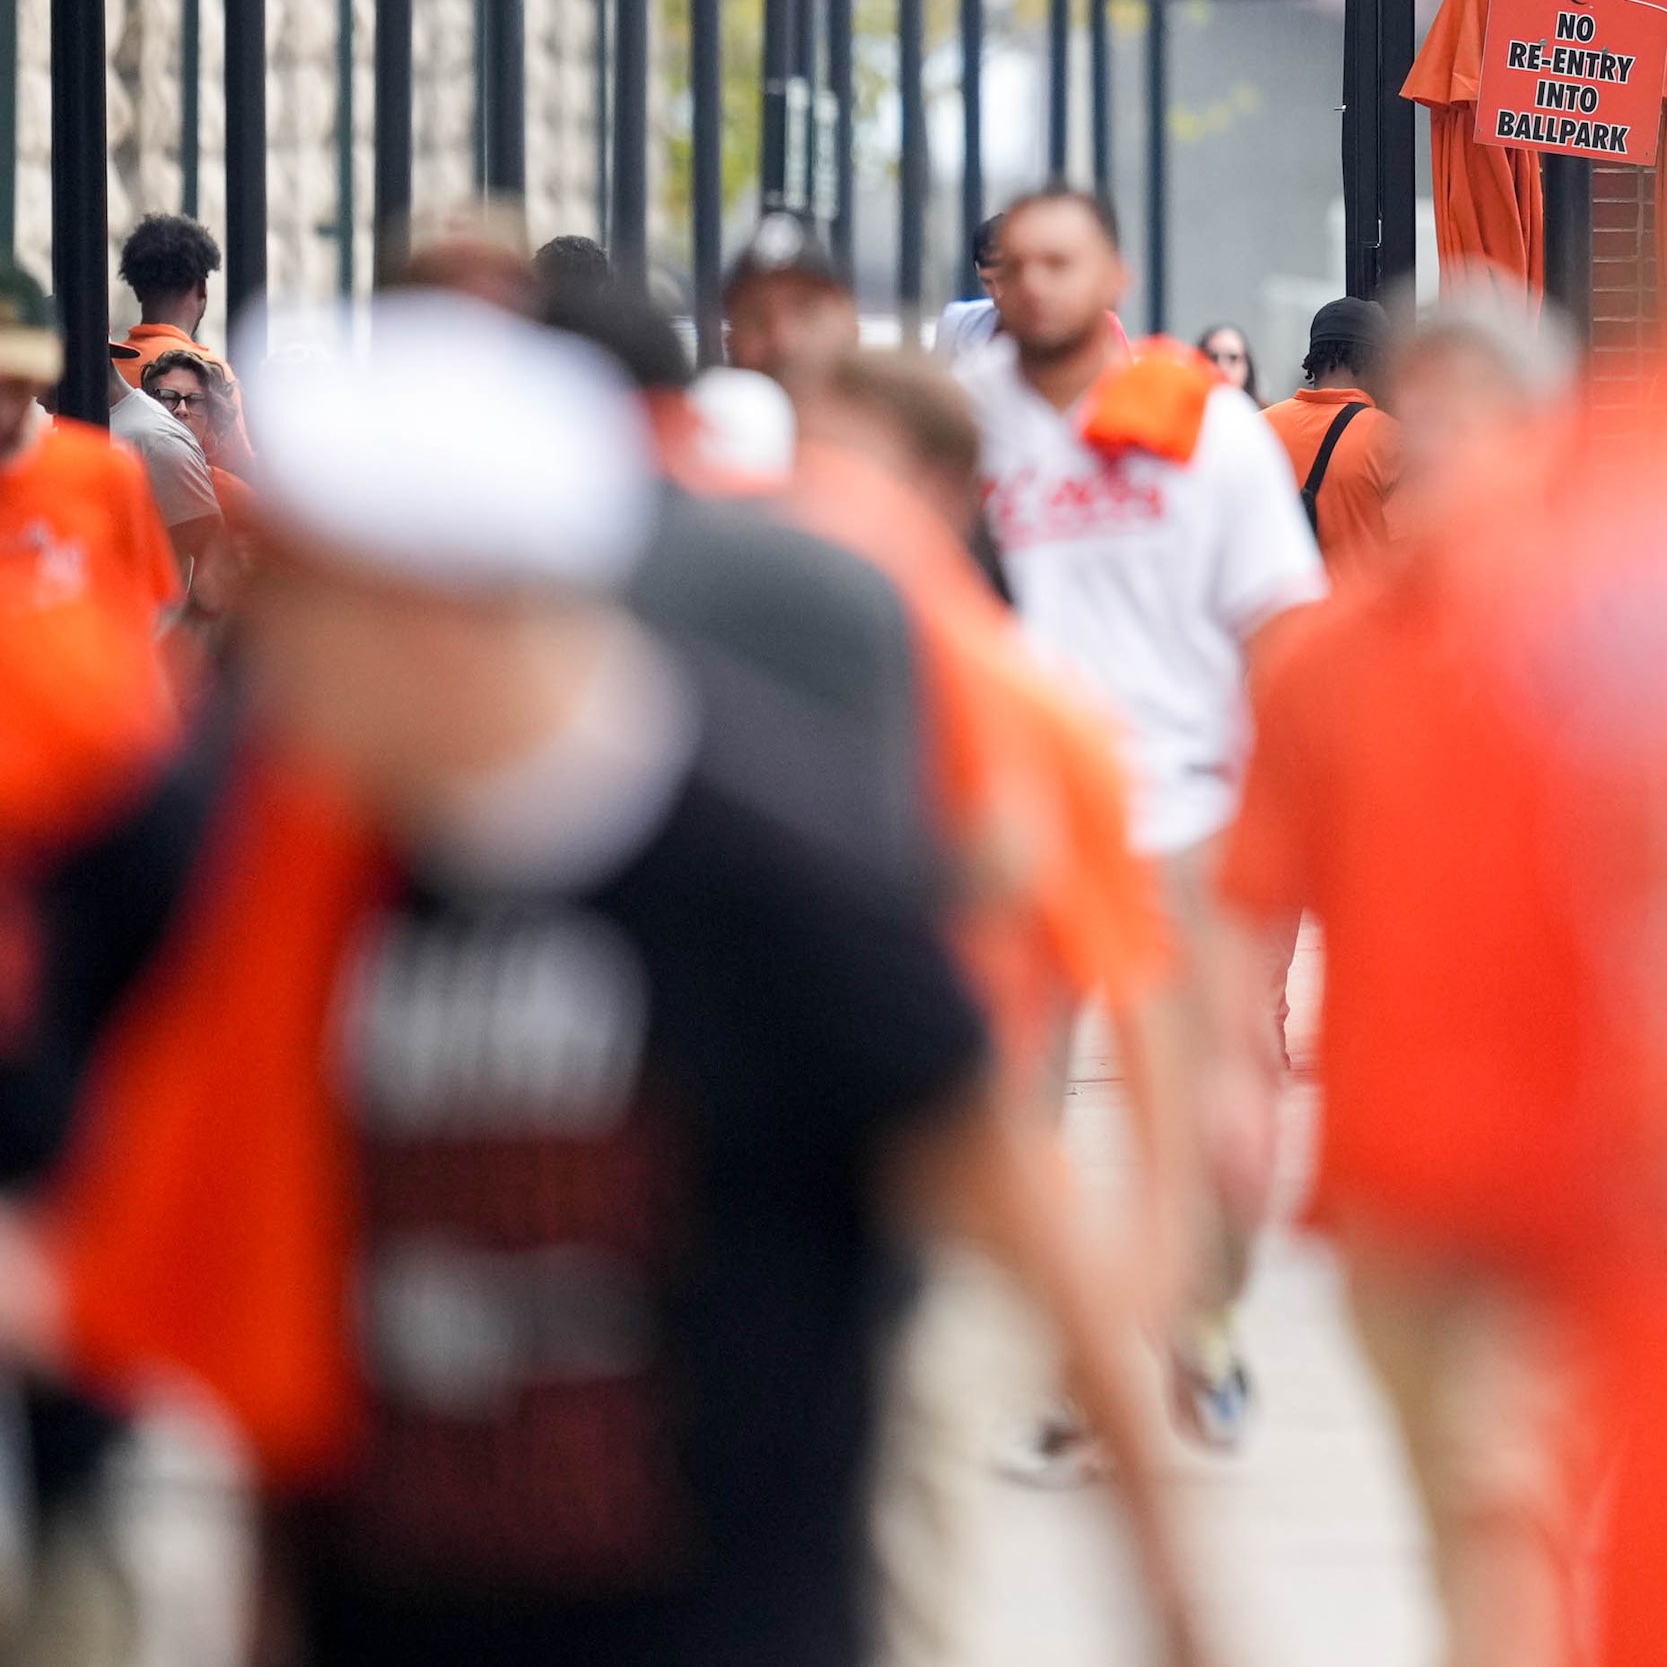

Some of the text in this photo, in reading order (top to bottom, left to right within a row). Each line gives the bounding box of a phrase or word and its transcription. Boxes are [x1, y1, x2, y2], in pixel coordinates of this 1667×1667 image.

[1555, 11, 1597, 43] NO
[1507, 40, 1636, 84] RE-ENTRY
[1534, 80, 1599, 115] INTO
[1495, 110, 1631, 154] BALLPARK
